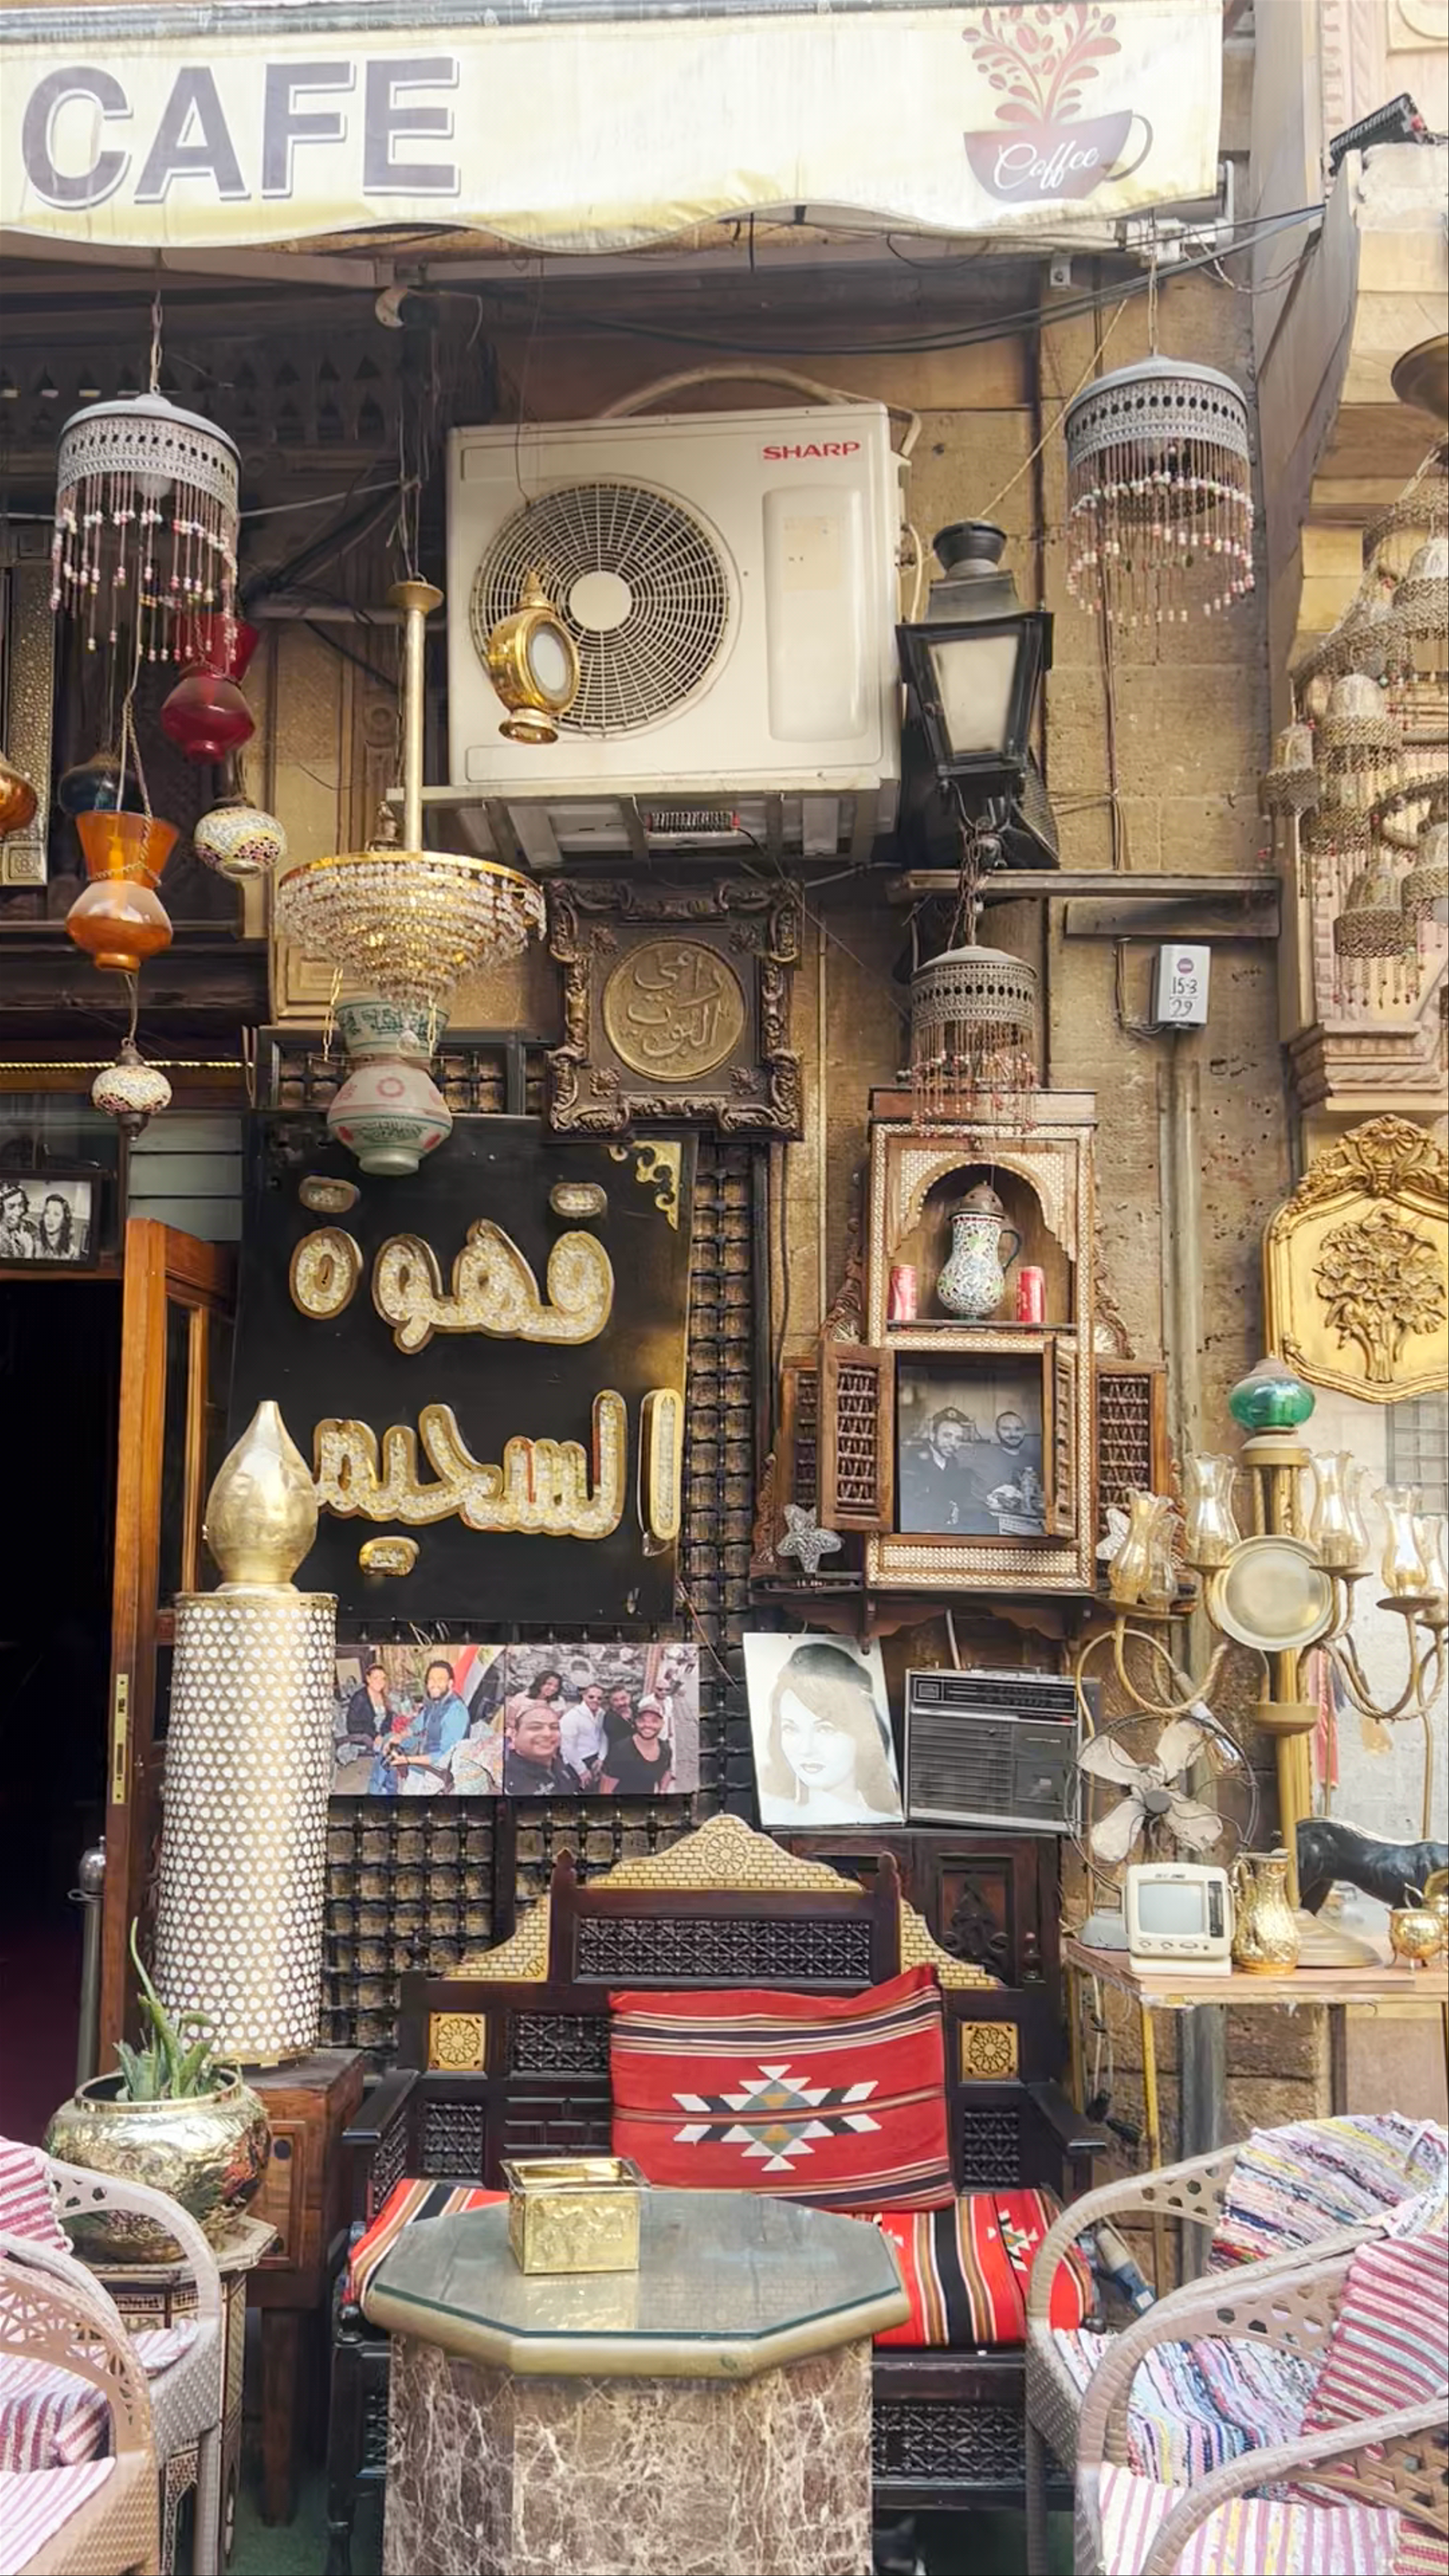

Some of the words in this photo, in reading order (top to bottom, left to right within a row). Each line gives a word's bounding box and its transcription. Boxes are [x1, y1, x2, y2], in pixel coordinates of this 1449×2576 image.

[22, 57, 461, 210] CAFE
[993, 140, 1100, 189] Coffee
[763, 441, 860, 460] SHARP
